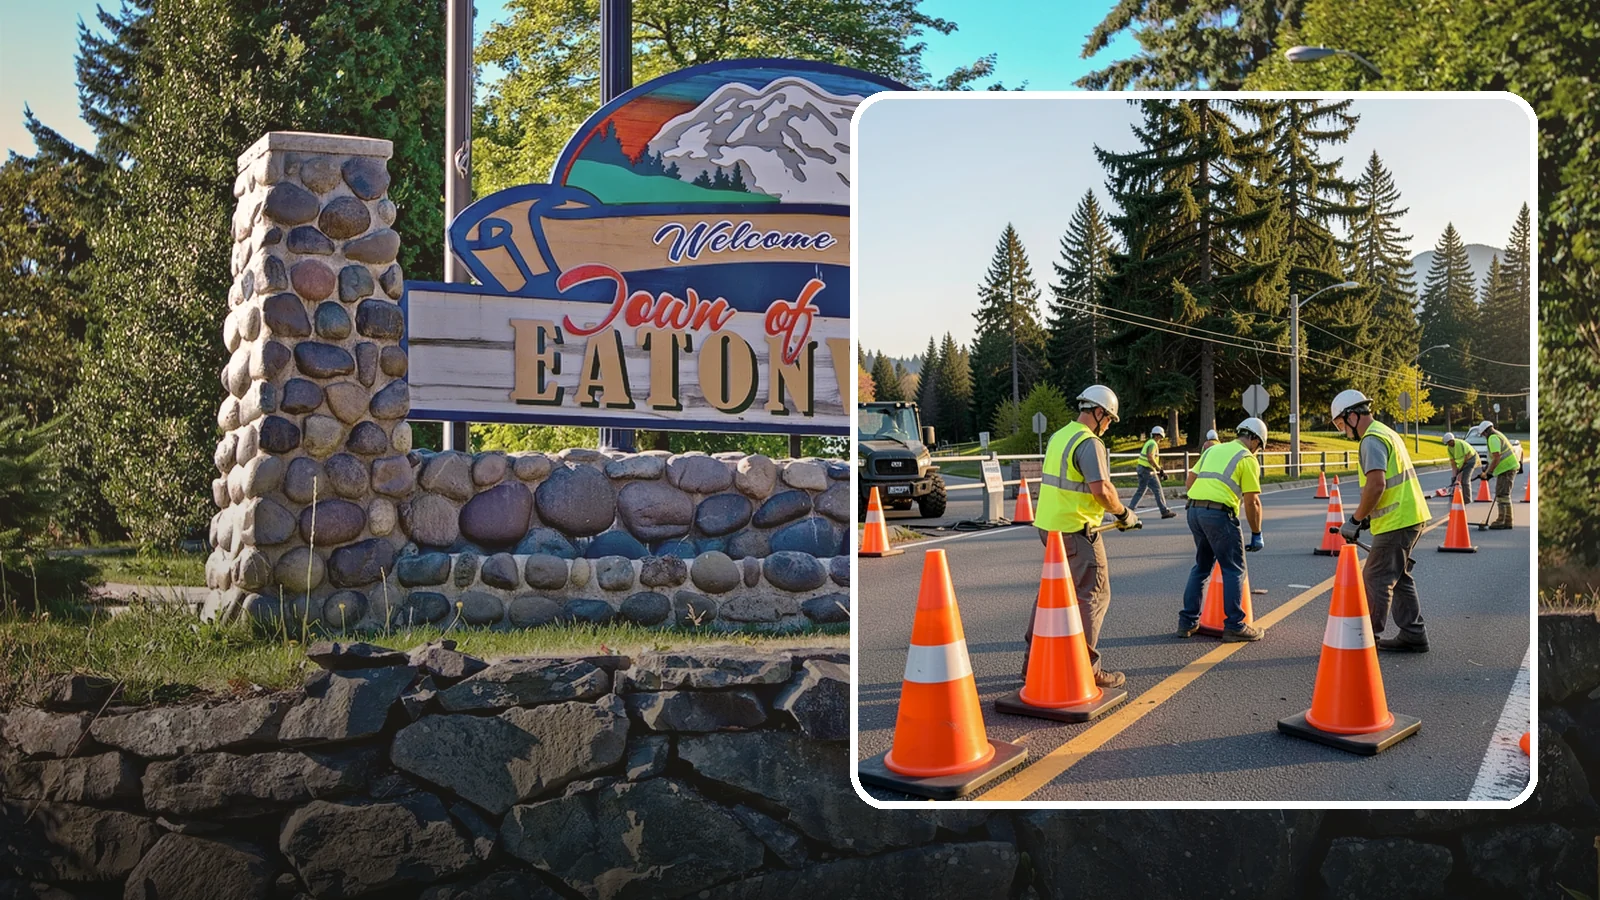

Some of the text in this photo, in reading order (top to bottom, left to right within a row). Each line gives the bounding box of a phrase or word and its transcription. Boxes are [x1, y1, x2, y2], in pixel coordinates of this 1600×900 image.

[653, 221, 838, 264] Welcome
[557, 264, 826, 365] Town of
